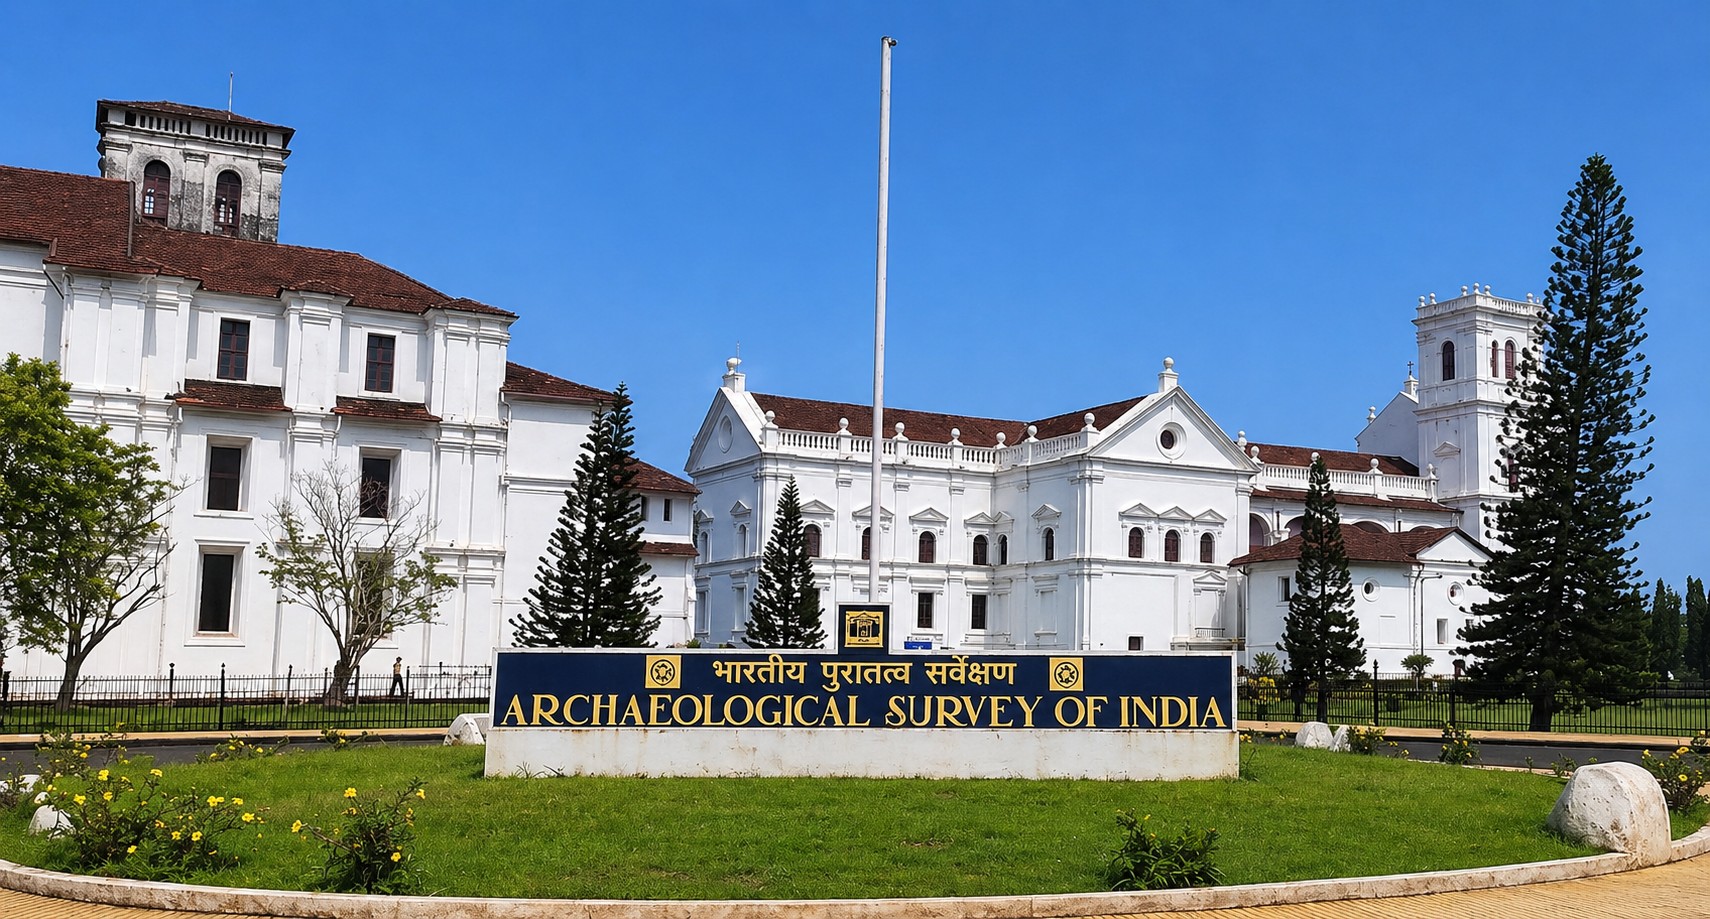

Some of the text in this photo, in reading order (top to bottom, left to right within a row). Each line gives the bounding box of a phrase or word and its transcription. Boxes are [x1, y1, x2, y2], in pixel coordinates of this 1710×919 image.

[712, 653, 1018, 693] भारतीय पुरातत्व सर्वेक्षण
[500, 694, 1227, 728] ARCHAEOLOGICAL SURVEY OF INDIA
